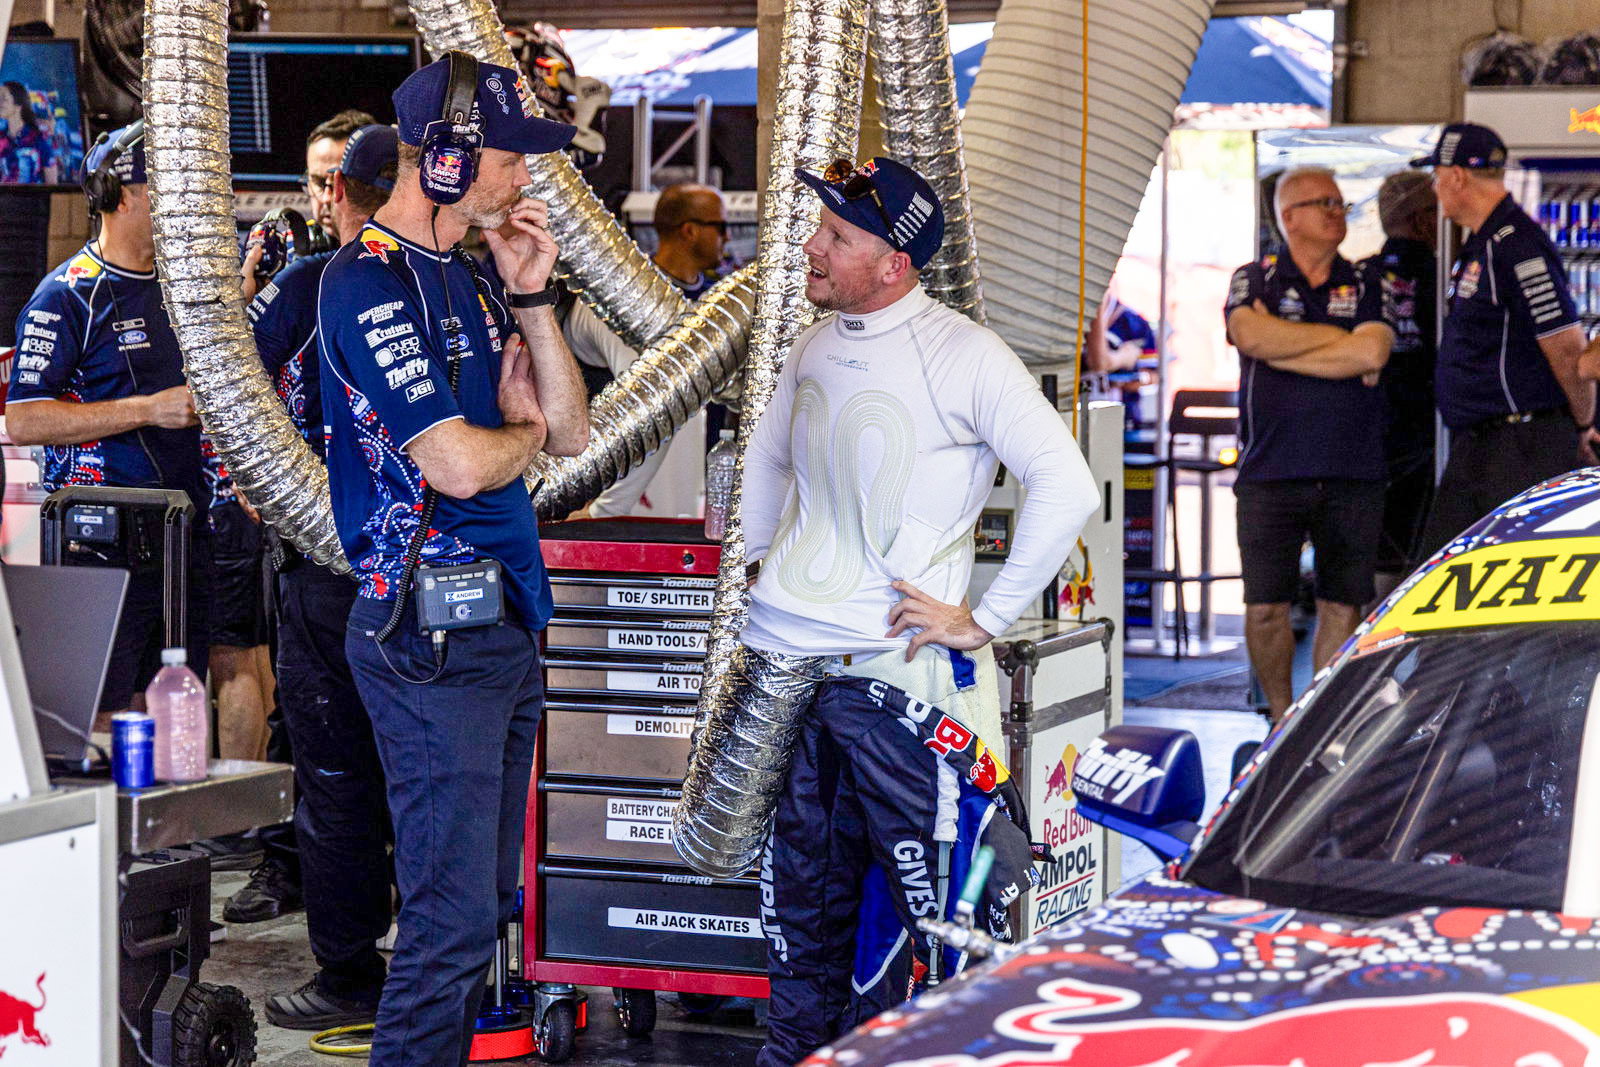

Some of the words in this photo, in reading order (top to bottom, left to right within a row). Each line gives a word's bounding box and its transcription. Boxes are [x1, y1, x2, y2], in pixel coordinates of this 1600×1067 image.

[432, 168, 461, 179] AMPOL
[357, 301, 404, 324] SUPERCHEAP
[374, 312, 392, 322] AUTO
[388, 336, 420, 352] QUAD
[393, 344, 422, 360] LOCK
[385, 357, 429, 387] Thrifty
[456, 590, 481, 599] ANDREW
[617, 591, 648, 604] TOE/
[651, 592, 709, 606] SPLITTER
[618, 633, 653, 646] HAND
[662, 662, 704, 673] ToolPR
[657, 676, 680, 689] AIR
[683, 677, 700, 690] TO
[662, 705, 697, 715] ToolP
[635, 720, 693, 734] DEMOLIT
[611, 803, 655, 817] BATTERY
[656, 805, 676, 818] CHA
[630, 826, 664, 840] RACE
[1044, 809, 1067, 848] Red
[1037, 843, 1096, 893] AMPOL
[661, 873, 713, 885] ToolPRO
[894, 840, 938, 917] GIVES
[1035, 878, 1093, 928] RACING
[635, 913, 658, 926] AIR
[662, 915, 696, 929] JACK
[699, 917, 750, 933] SKATES
